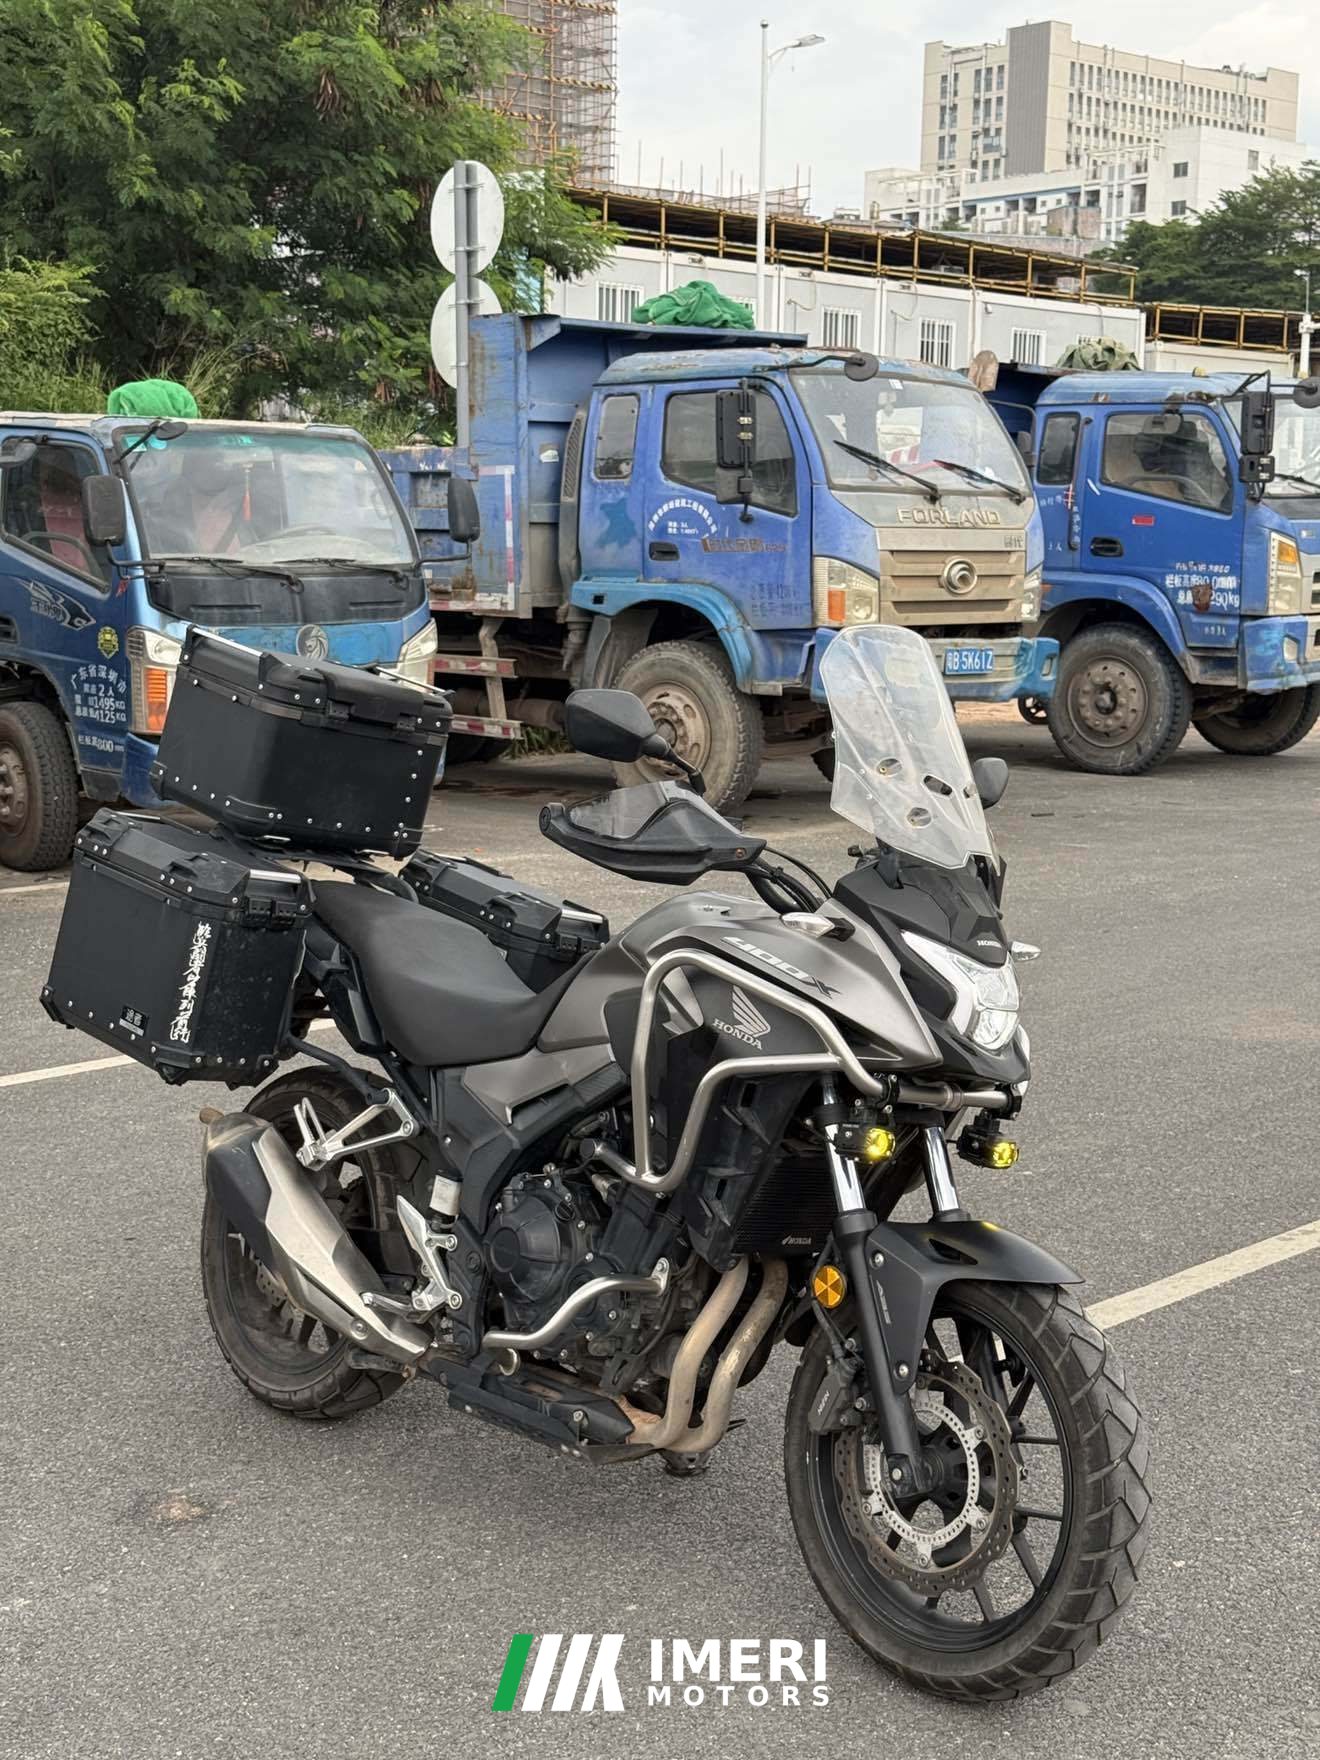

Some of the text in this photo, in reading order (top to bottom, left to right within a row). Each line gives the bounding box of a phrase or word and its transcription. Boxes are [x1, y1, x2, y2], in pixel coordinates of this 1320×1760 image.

[896, 505, 1001, 528] FORLAND
[720, 936, 842, 999] 400X
[712, 1018, 763, 1050] HONDA
